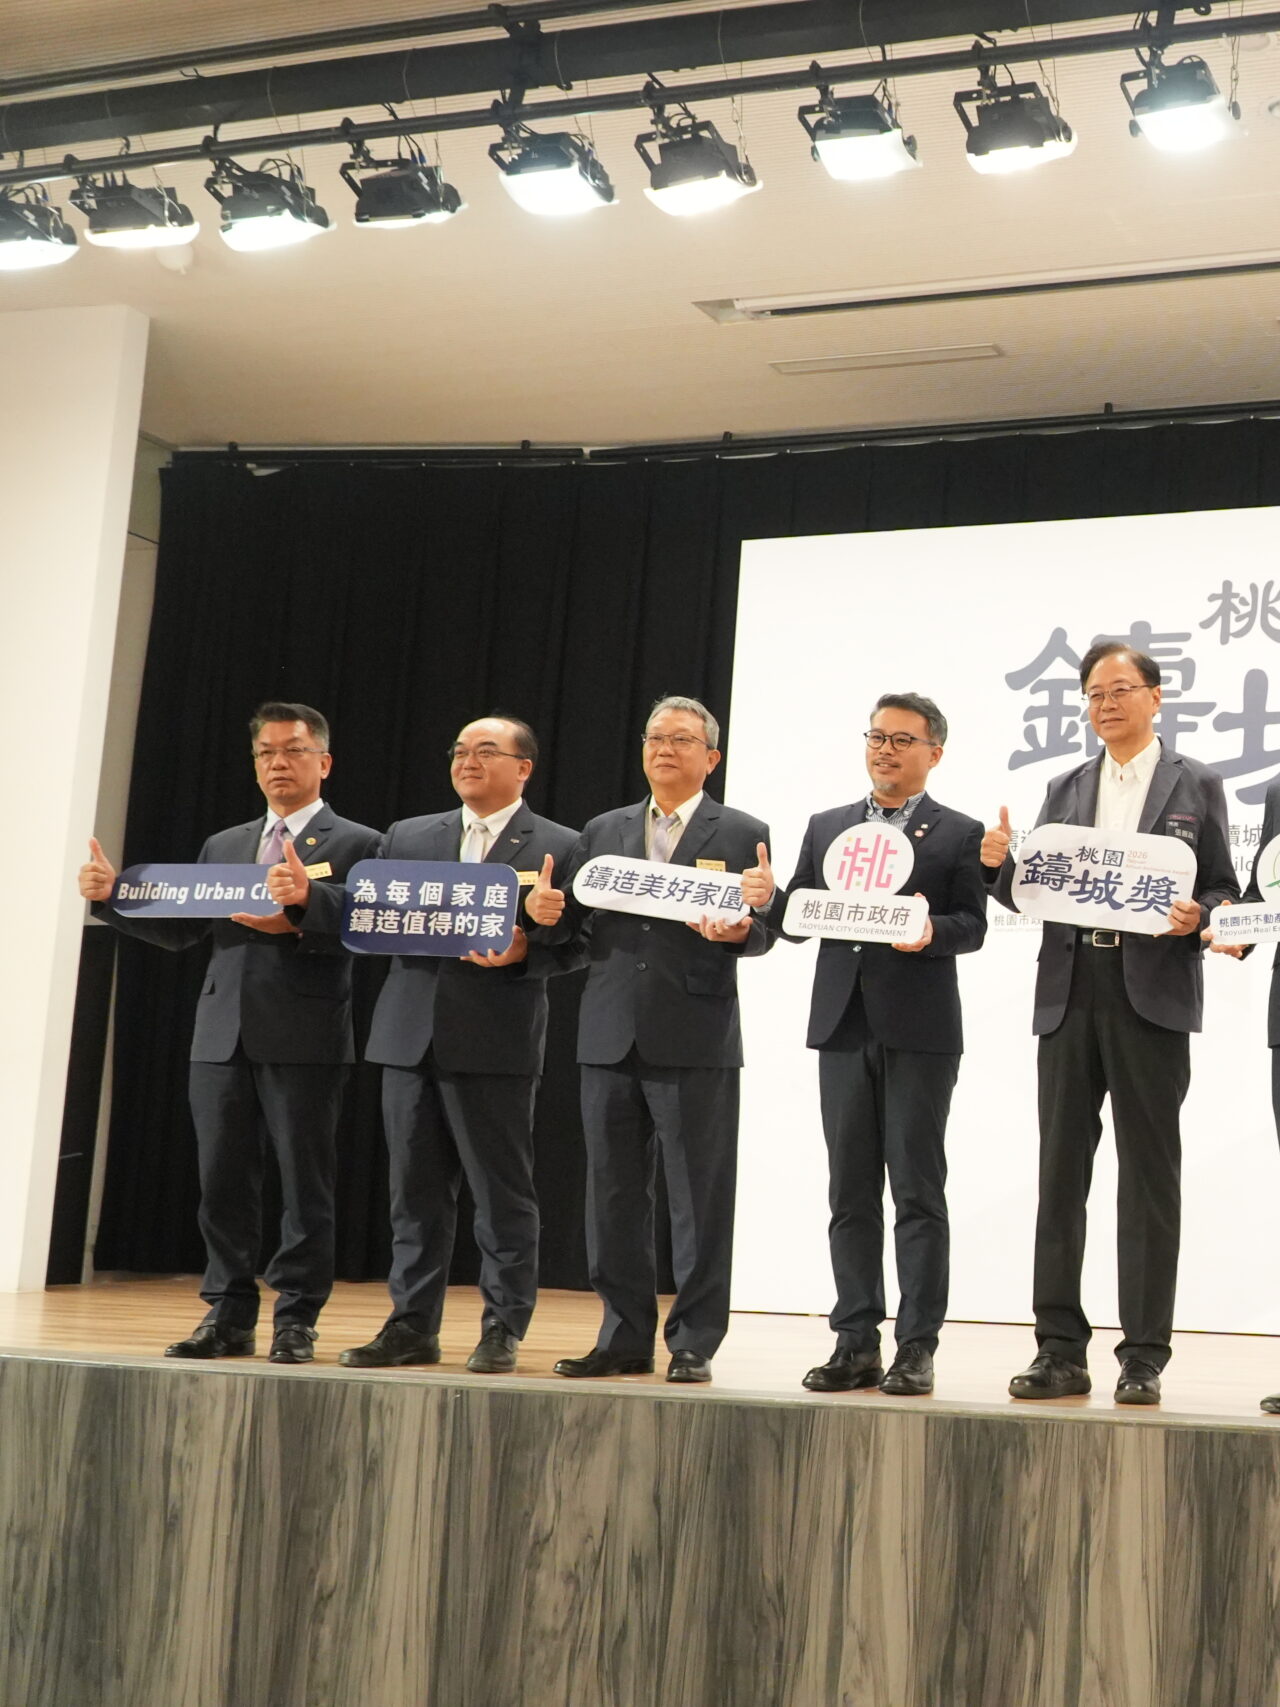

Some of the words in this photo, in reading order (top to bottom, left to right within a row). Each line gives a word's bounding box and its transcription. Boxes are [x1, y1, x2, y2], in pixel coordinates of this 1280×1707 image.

[1075, 846, 1124, 867] 桃園
[118, 882, 189, 904] Building
[194, 883, 244, 900] Urban
[353, 879, 509, 908] 為每個家庭
[582, 864, 743, 912] 鑄造美好家園
[1019, 850, 1179, 916] 鑄城獎
[349, 908, 506, 937] 鑄造值得的家
[801, 900, 911, 926] 桃園市政府
[798, 923, 834, 931] TAOYUAN
[835, 924, 852, 932] CITY
[853, 926, 907, 937] GOVERNMENT
[1219, 928, 1252, 937] Taoyuan
[1253, 927, 1271, 935] Real
